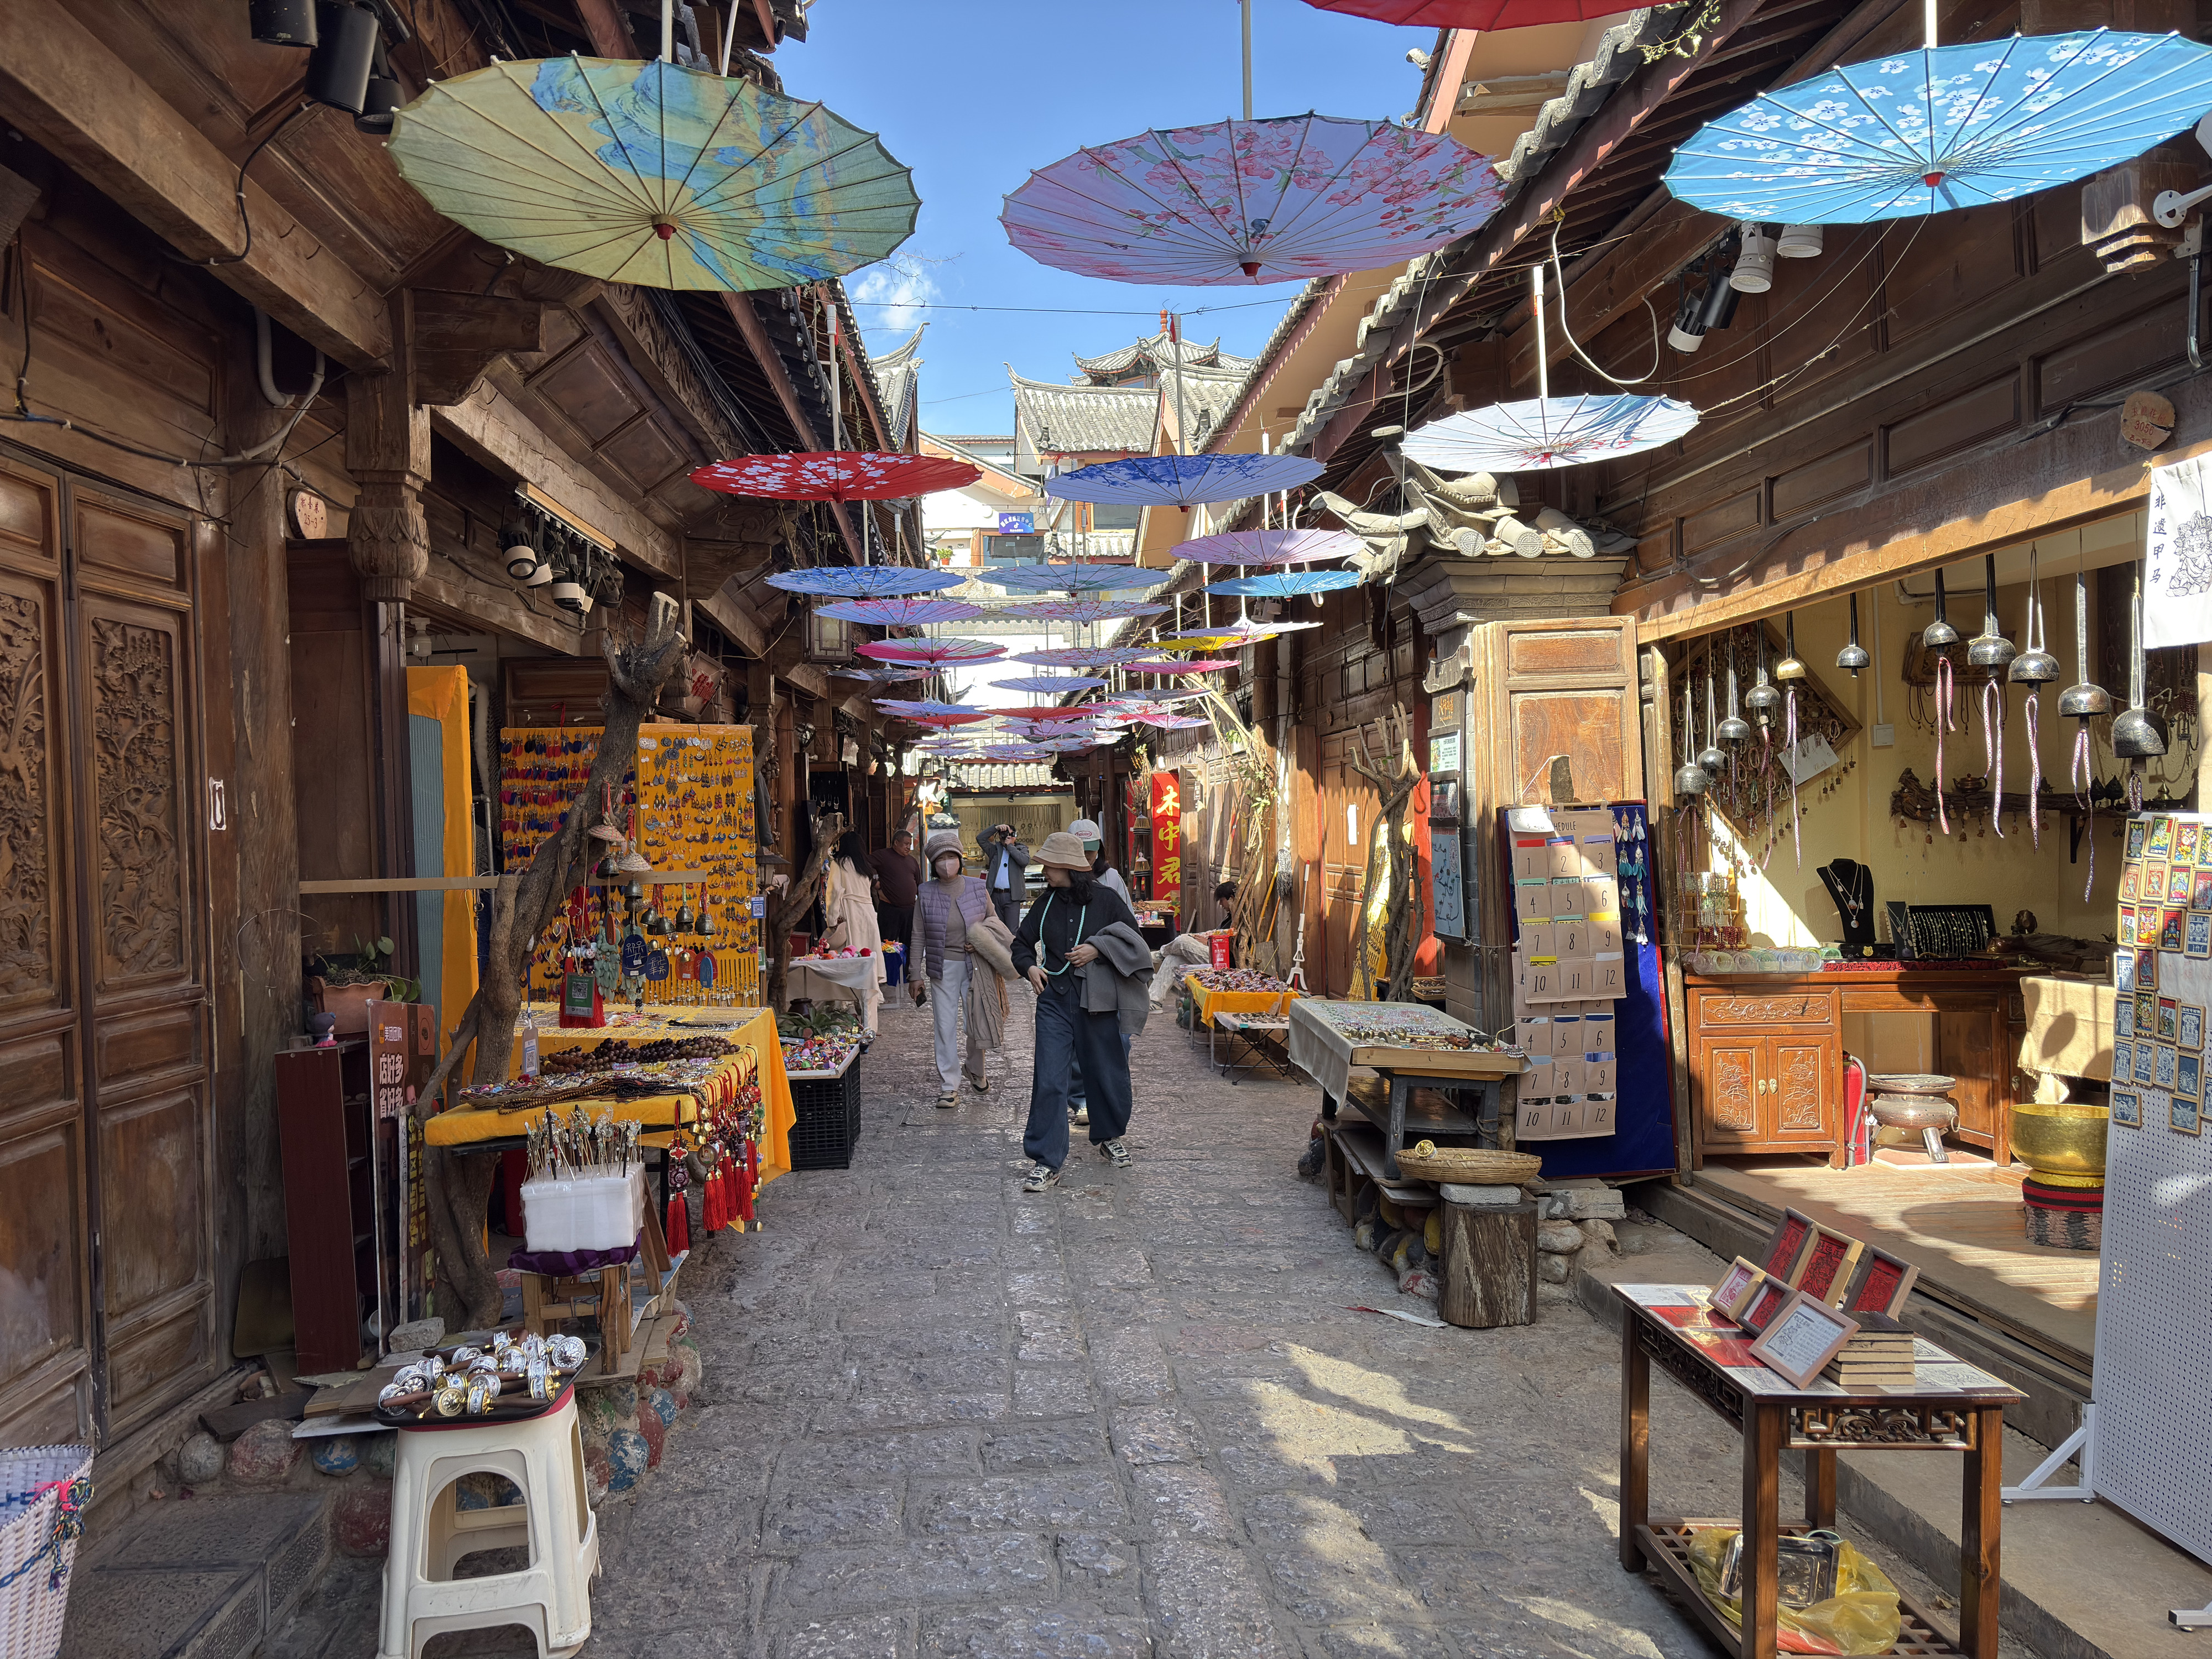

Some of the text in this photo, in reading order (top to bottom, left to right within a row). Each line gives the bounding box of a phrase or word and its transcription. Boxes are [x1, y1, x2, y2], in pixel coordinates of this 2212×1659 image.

[2134, 420, 2154, 436] 3056
[304, 513, 317, 529] 25-3
[2149, 493, 2167, 584] 非遗甲马
[1553, 821, 1577, 831] HEDULE
[1527, 857, 1530, 874] 1
[1561, 855, 1567, 872] 2
[1598, 852, 1603, 869] 3
[1530, 896, 1536, 914] 4
[1567, 893, 1572, 910] 5
[1601, 890, 1607, 907] 6
[1534, 935, 1540, 952] 7
[1569, 933, 1575, 950] 8
[1605, 930, 1610, 947] 9
[1534, 975, 1546, 992] 10
[1572, 973, 1580, 989] 11
[1606, 969, 1616, 986] 12
[384, 1026, 402, 1041] 美团团购
[1528, 1034, 1533, 1050] 4
[1561, 1032, 1566, 1048] 5
[1597, 1030, 1603, 1046] 6
[379, 1053, 404, 1084] 店好多
[1532, 1074, 1537, 1089] 7
[1564, 1071, 1569, 1088] 8
[1599, 1070, 1605, 1086] 9
[379, 1086, 403, 1119] 省好多
[1526, 1112, 1540, 1126] 10
[1562, 1111, 1571, 1125] 11
[1595, 1108, 1606, 1123] 12
